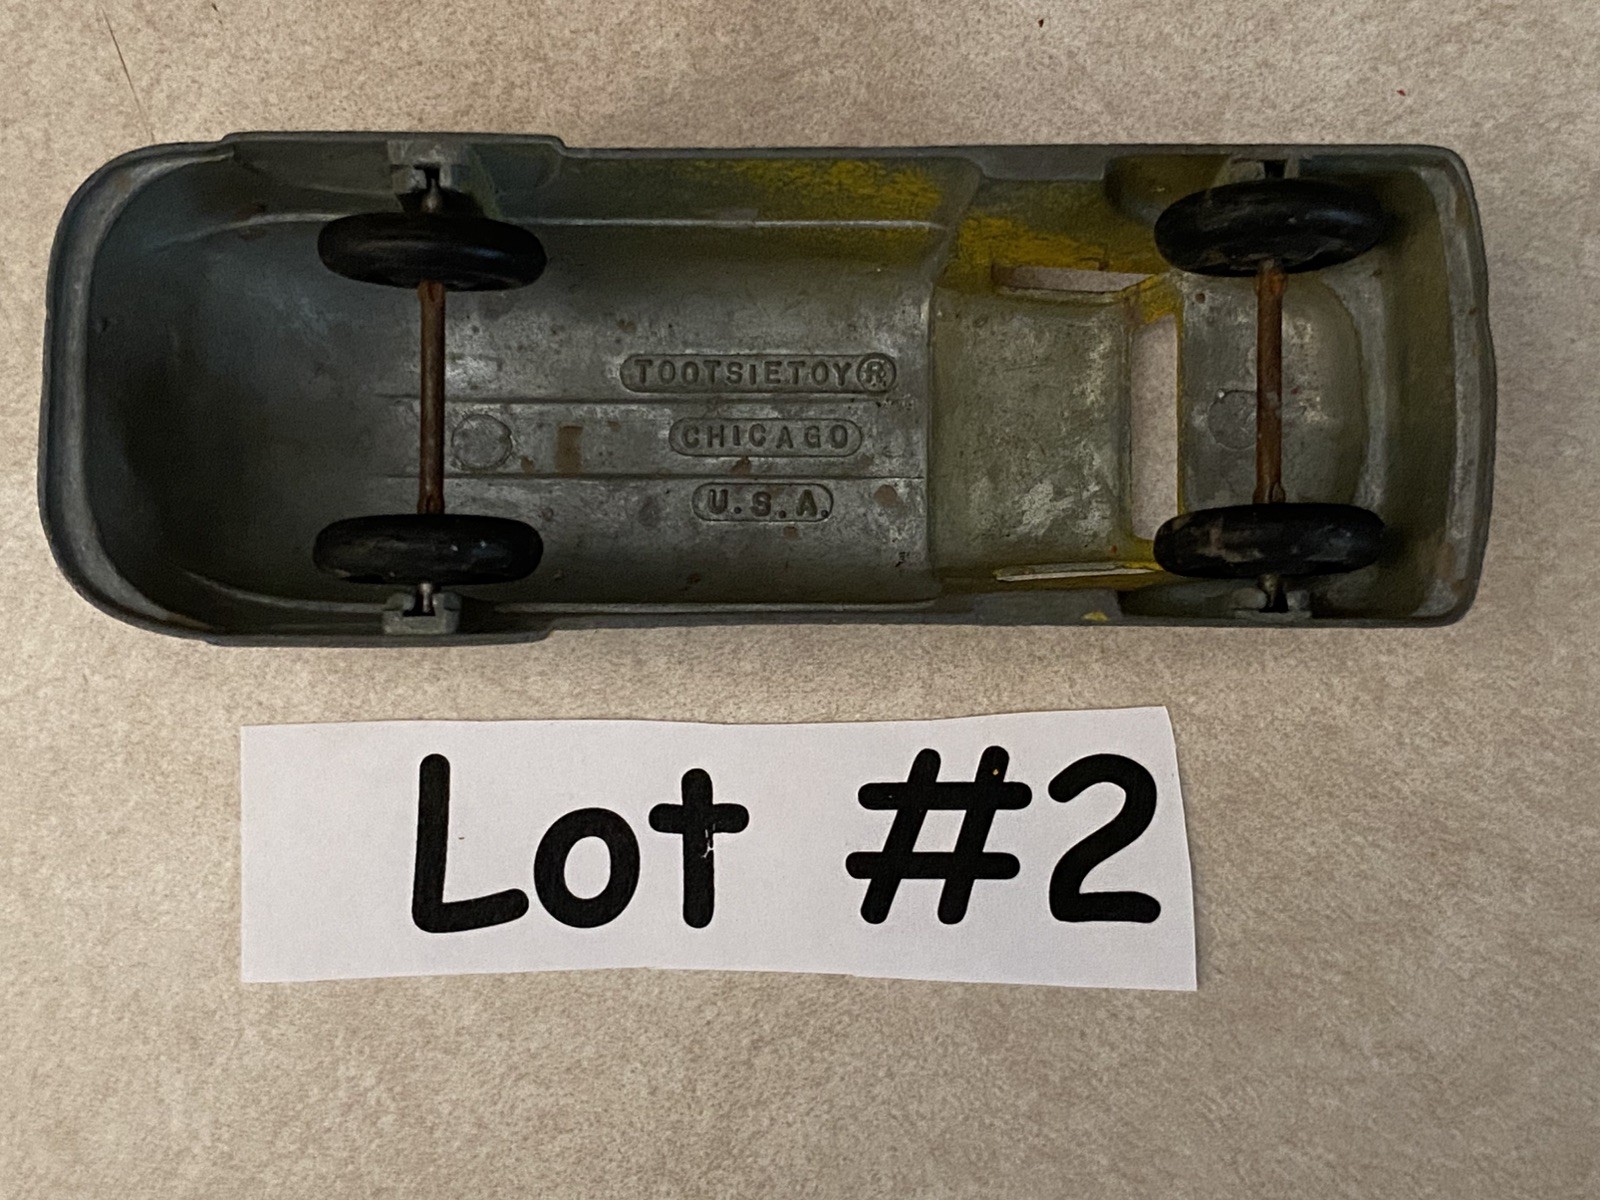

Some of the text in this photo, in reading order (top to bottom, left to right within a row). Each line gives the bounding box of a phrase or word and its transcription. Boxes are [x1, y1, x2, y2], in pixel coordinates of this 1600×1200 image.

[681, 424, 848, 449] CHICAGO
[706, 489, 829, 519] U.S.A.
[411, 745, 1162, 934] Lot #2
